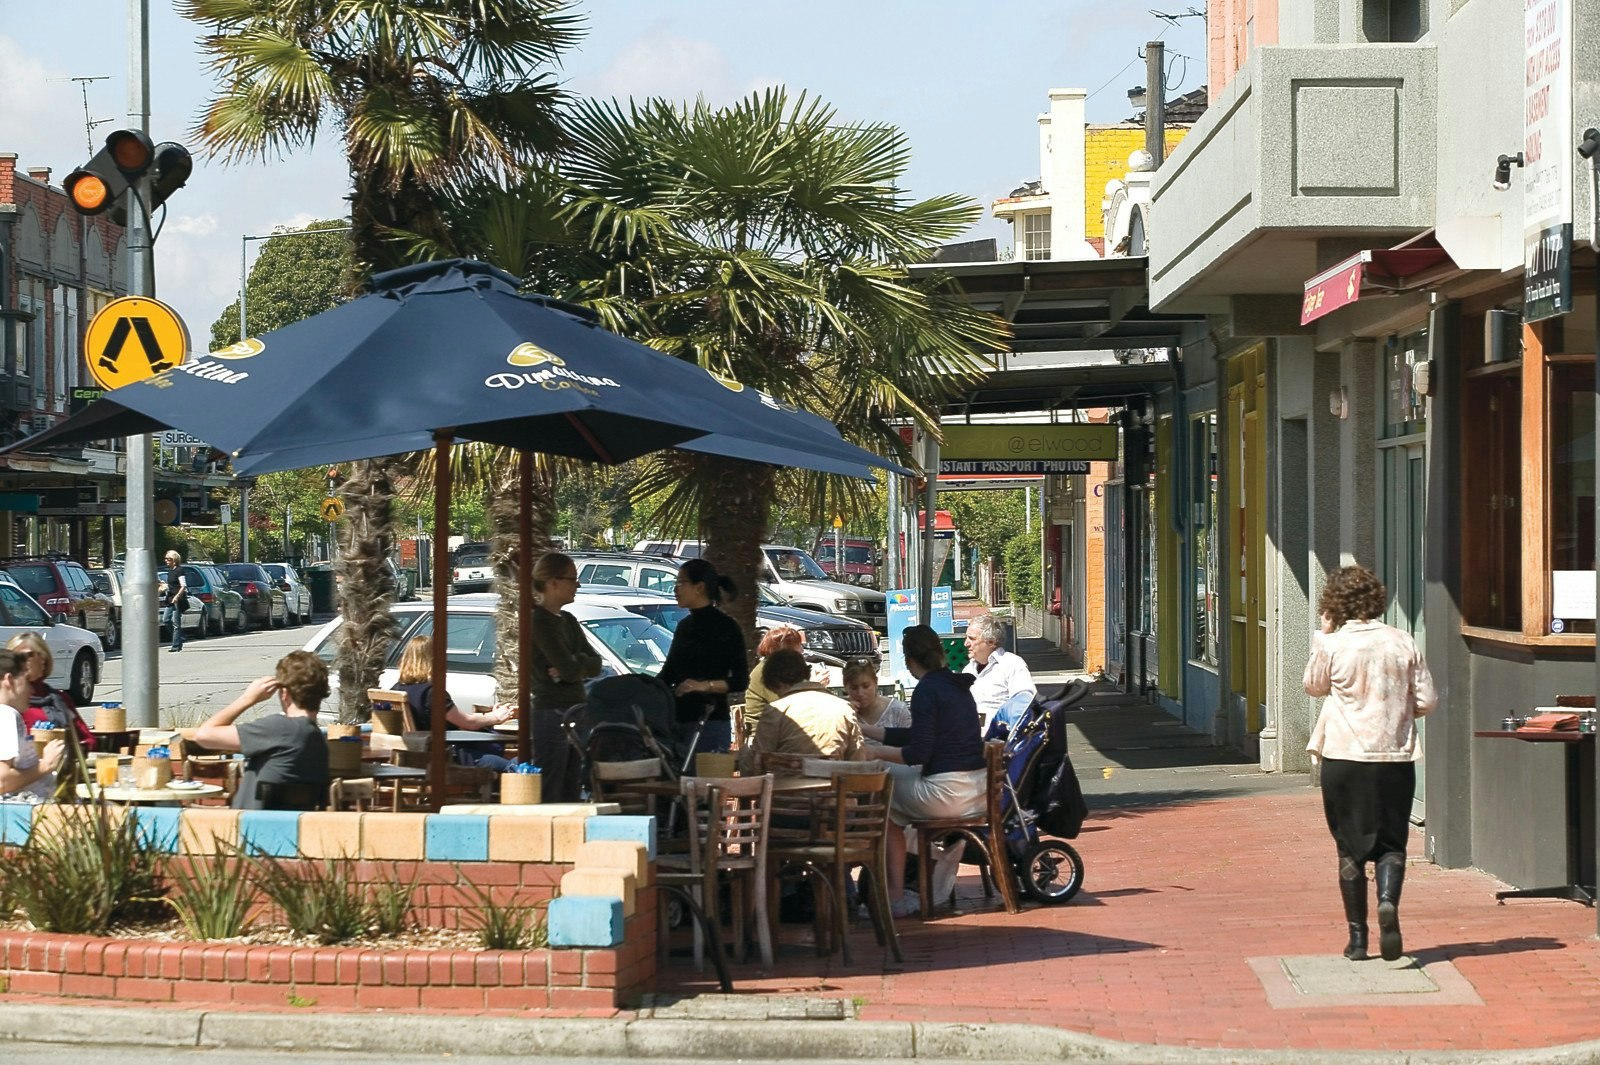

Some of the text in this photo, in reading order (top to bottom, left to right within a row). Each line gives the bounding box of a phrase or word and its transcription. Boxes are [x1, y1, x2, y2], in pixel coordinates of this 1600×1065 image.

[1545, 37, 1561, 76] ACCESS
[981, 460, 1038, 472] PASSPORT
[1043, 460, 1087, 472] PHOTOS
